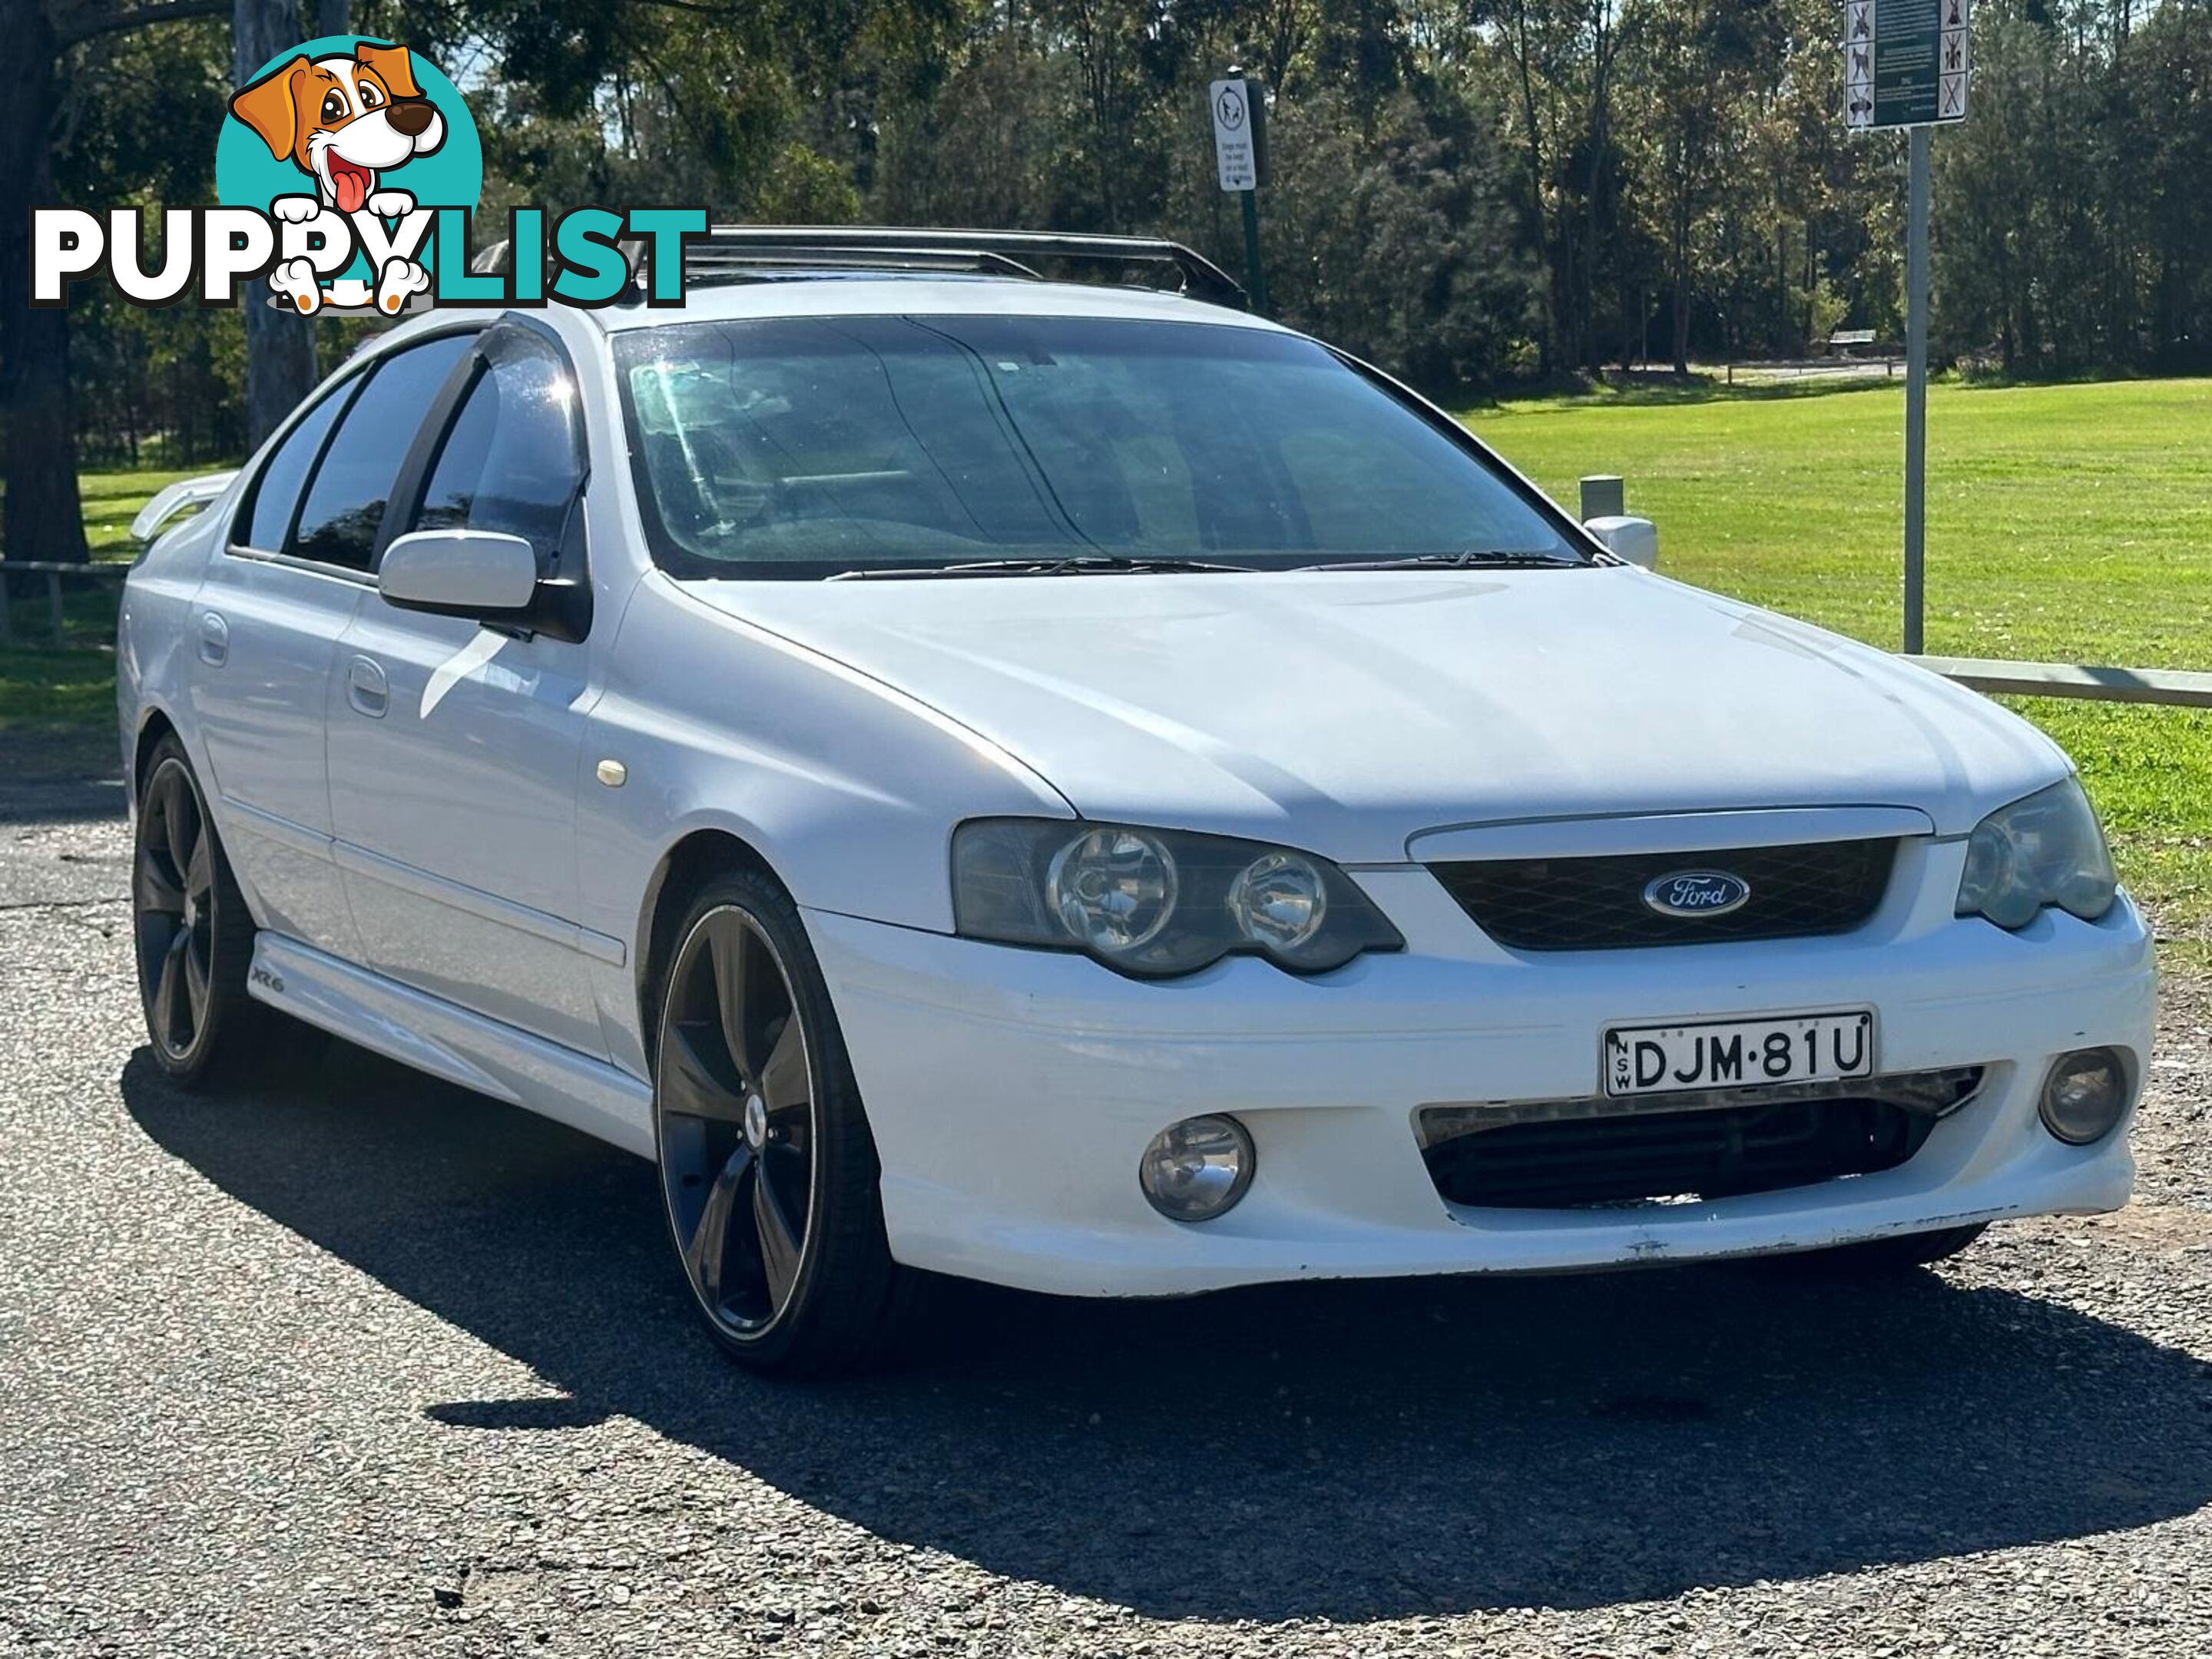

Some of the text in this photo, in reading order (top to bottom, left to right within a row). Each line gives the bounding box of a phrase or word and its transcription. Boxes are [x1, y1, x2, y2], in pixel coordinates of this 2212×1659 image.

[1670, 878, 1727, 906] Ford
[251, 966, 285, 993] XR6
[1615, 1040, 1631, 1089] NSW
